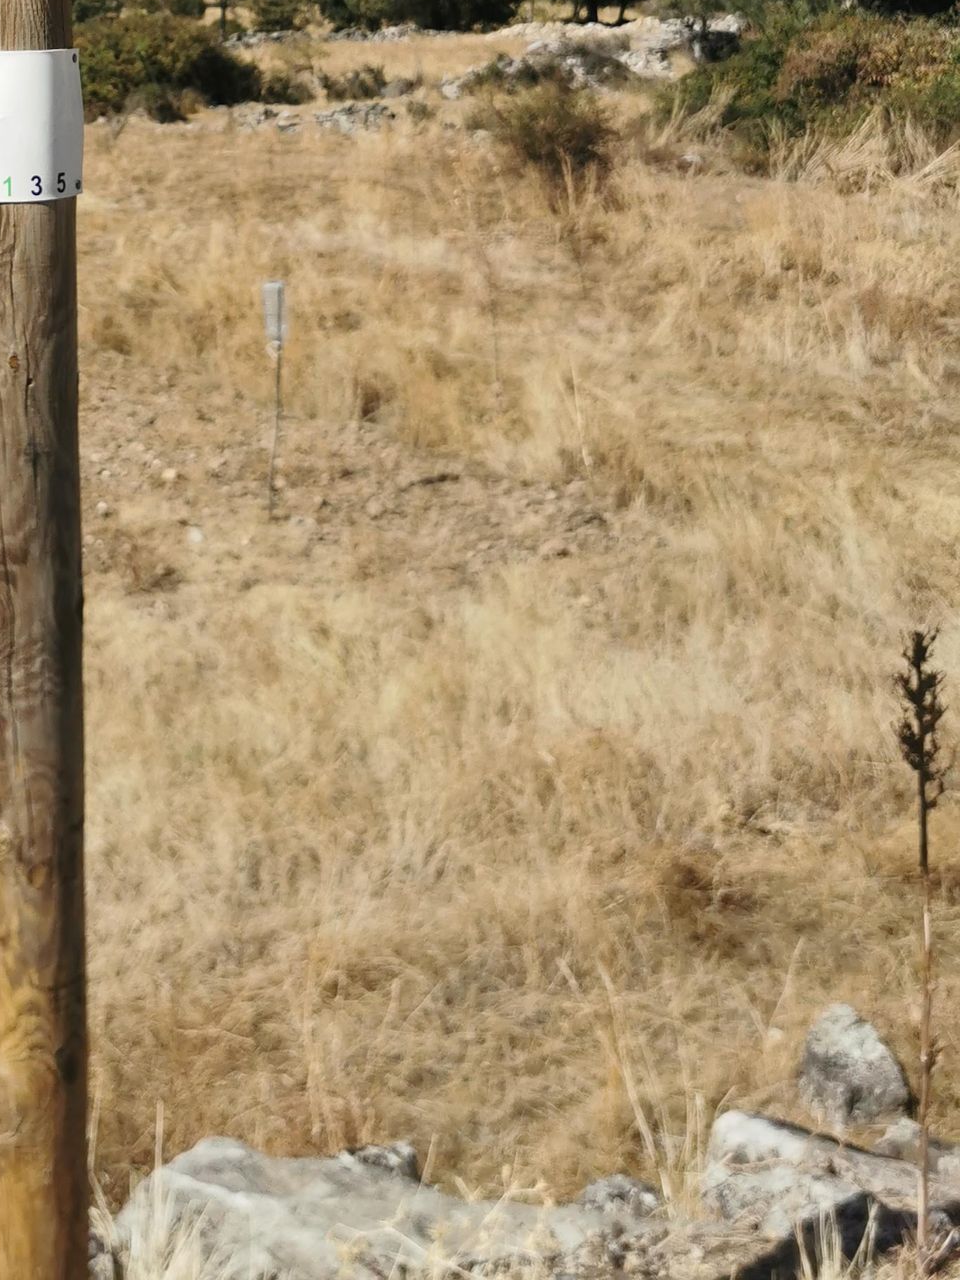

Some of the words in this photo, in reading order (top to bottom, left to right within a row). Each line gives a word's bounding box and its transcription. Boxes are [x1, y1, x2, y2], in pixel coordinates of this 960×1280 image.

[3, 176, 12, 197] 1
[30, 175, 43, 196] 3
[57, 172, 66, 193] 5
